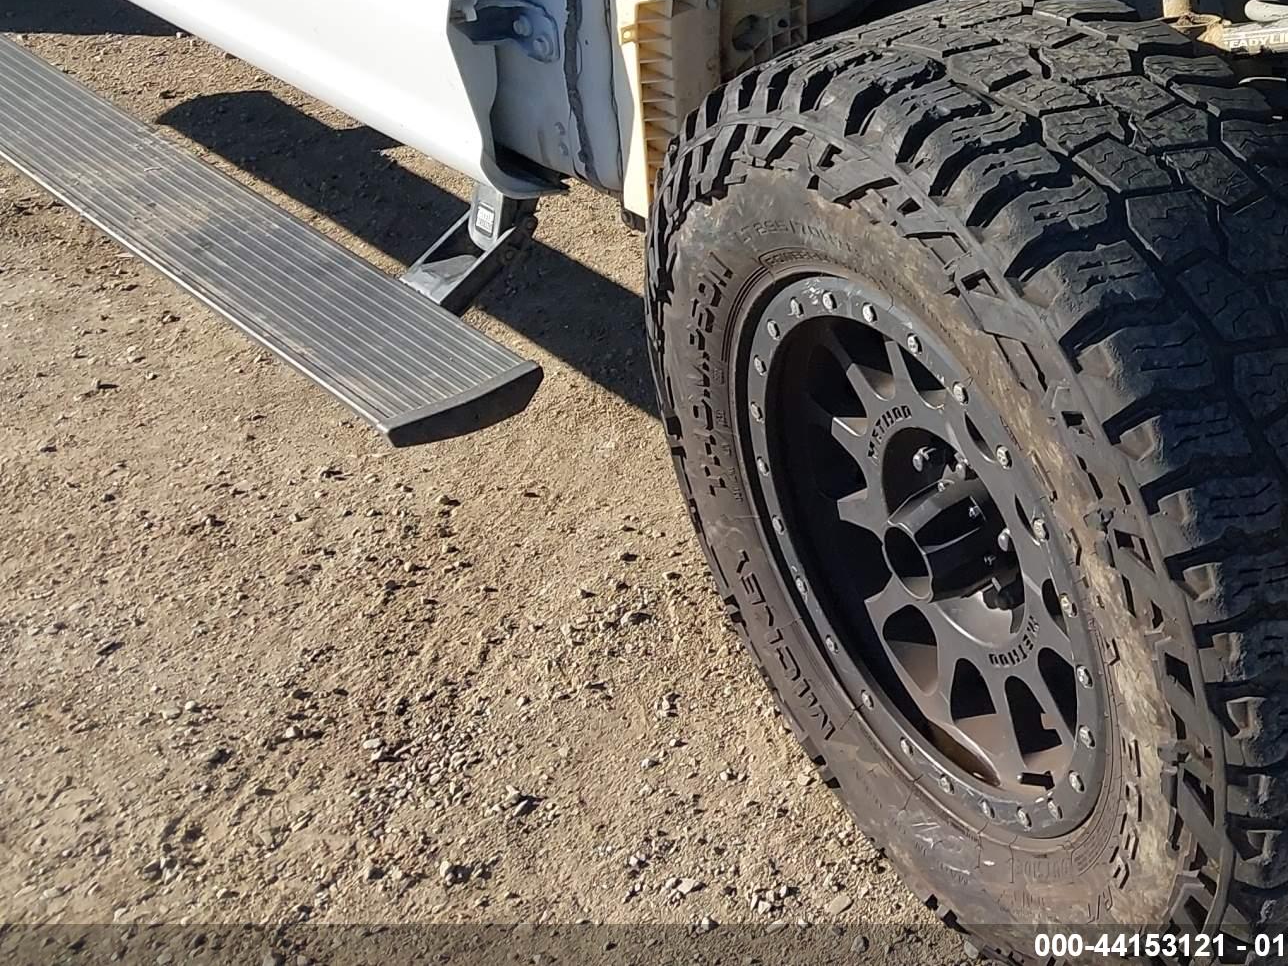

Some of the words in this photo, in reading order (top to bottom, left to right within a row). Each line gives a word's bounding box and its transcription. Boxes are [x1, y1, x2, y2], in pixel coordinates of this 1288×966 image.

[688, 250, 734, 497] THOMPSON
[868, 404, 913, 466] METHOD
[736, 548, 837, 741] MICKEY
[988, 614, 1040, 667] METHOD
